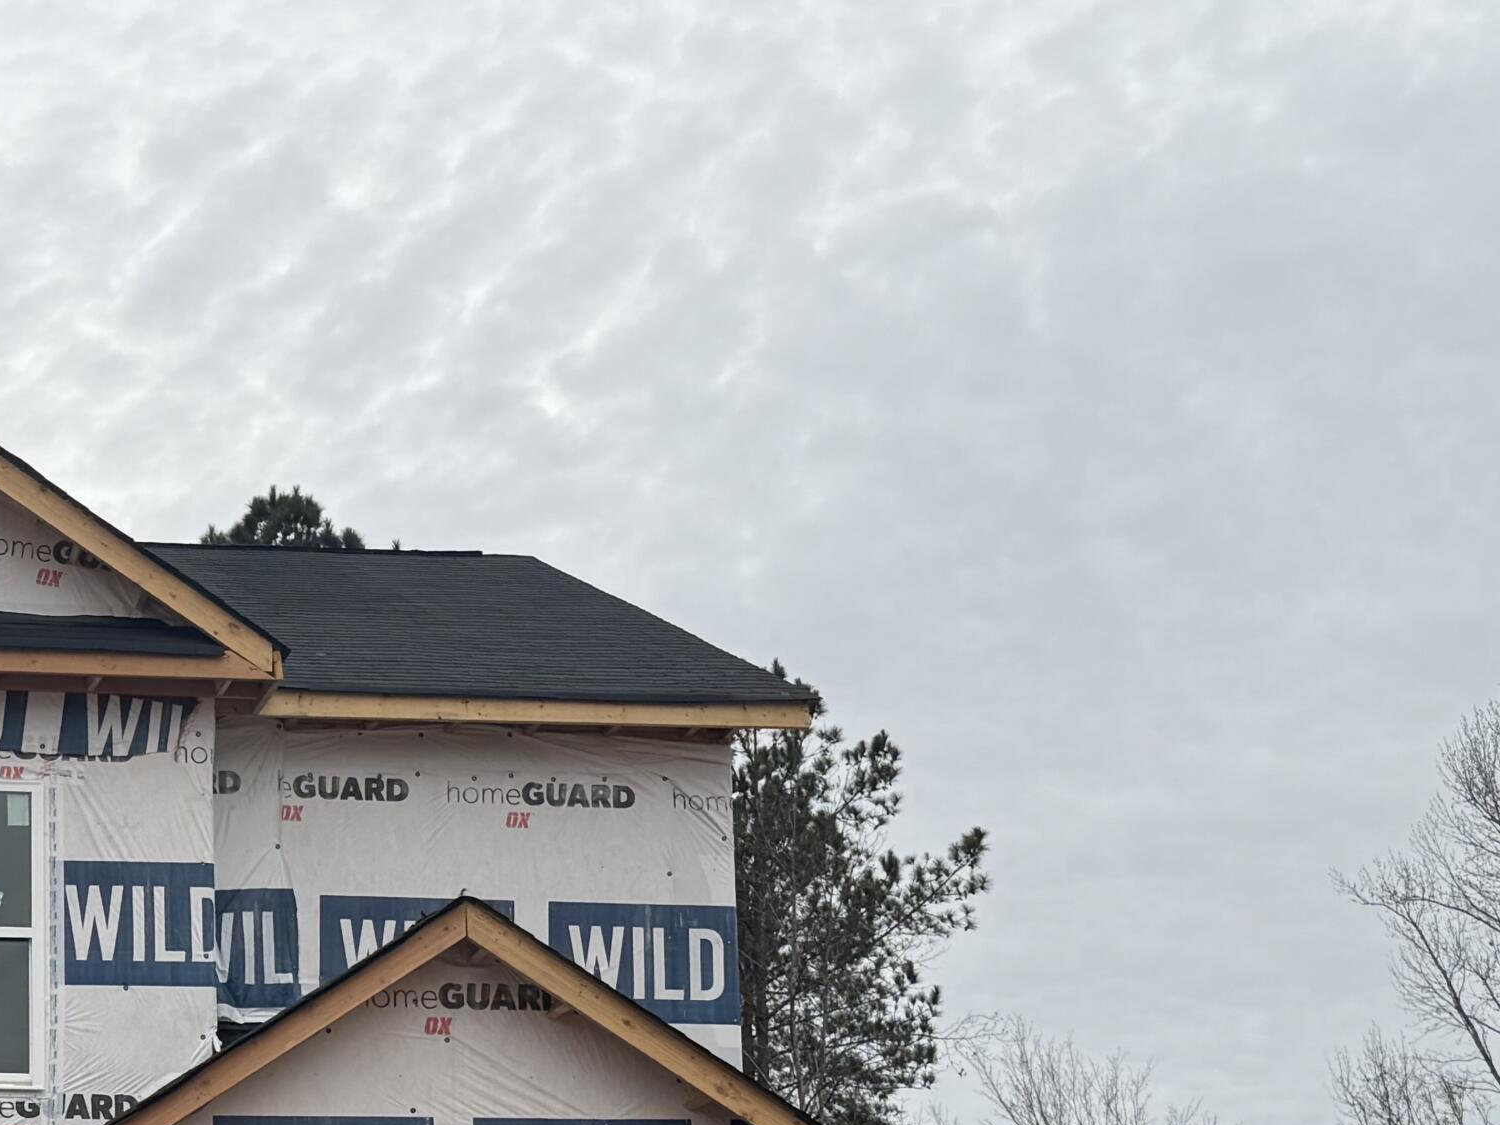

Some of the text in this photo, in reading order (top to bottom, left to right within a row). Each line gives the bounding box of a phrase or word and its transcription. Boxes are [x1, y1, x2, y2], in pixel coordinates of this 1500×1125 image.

[35, 567, 64, 587] OX
[447, 780, 636, 809] homeGUARD
[505, 811, 531, 829] OX
[568, 924, 726, 1001] WILD
[424, 1016, 452, 1036] OX
